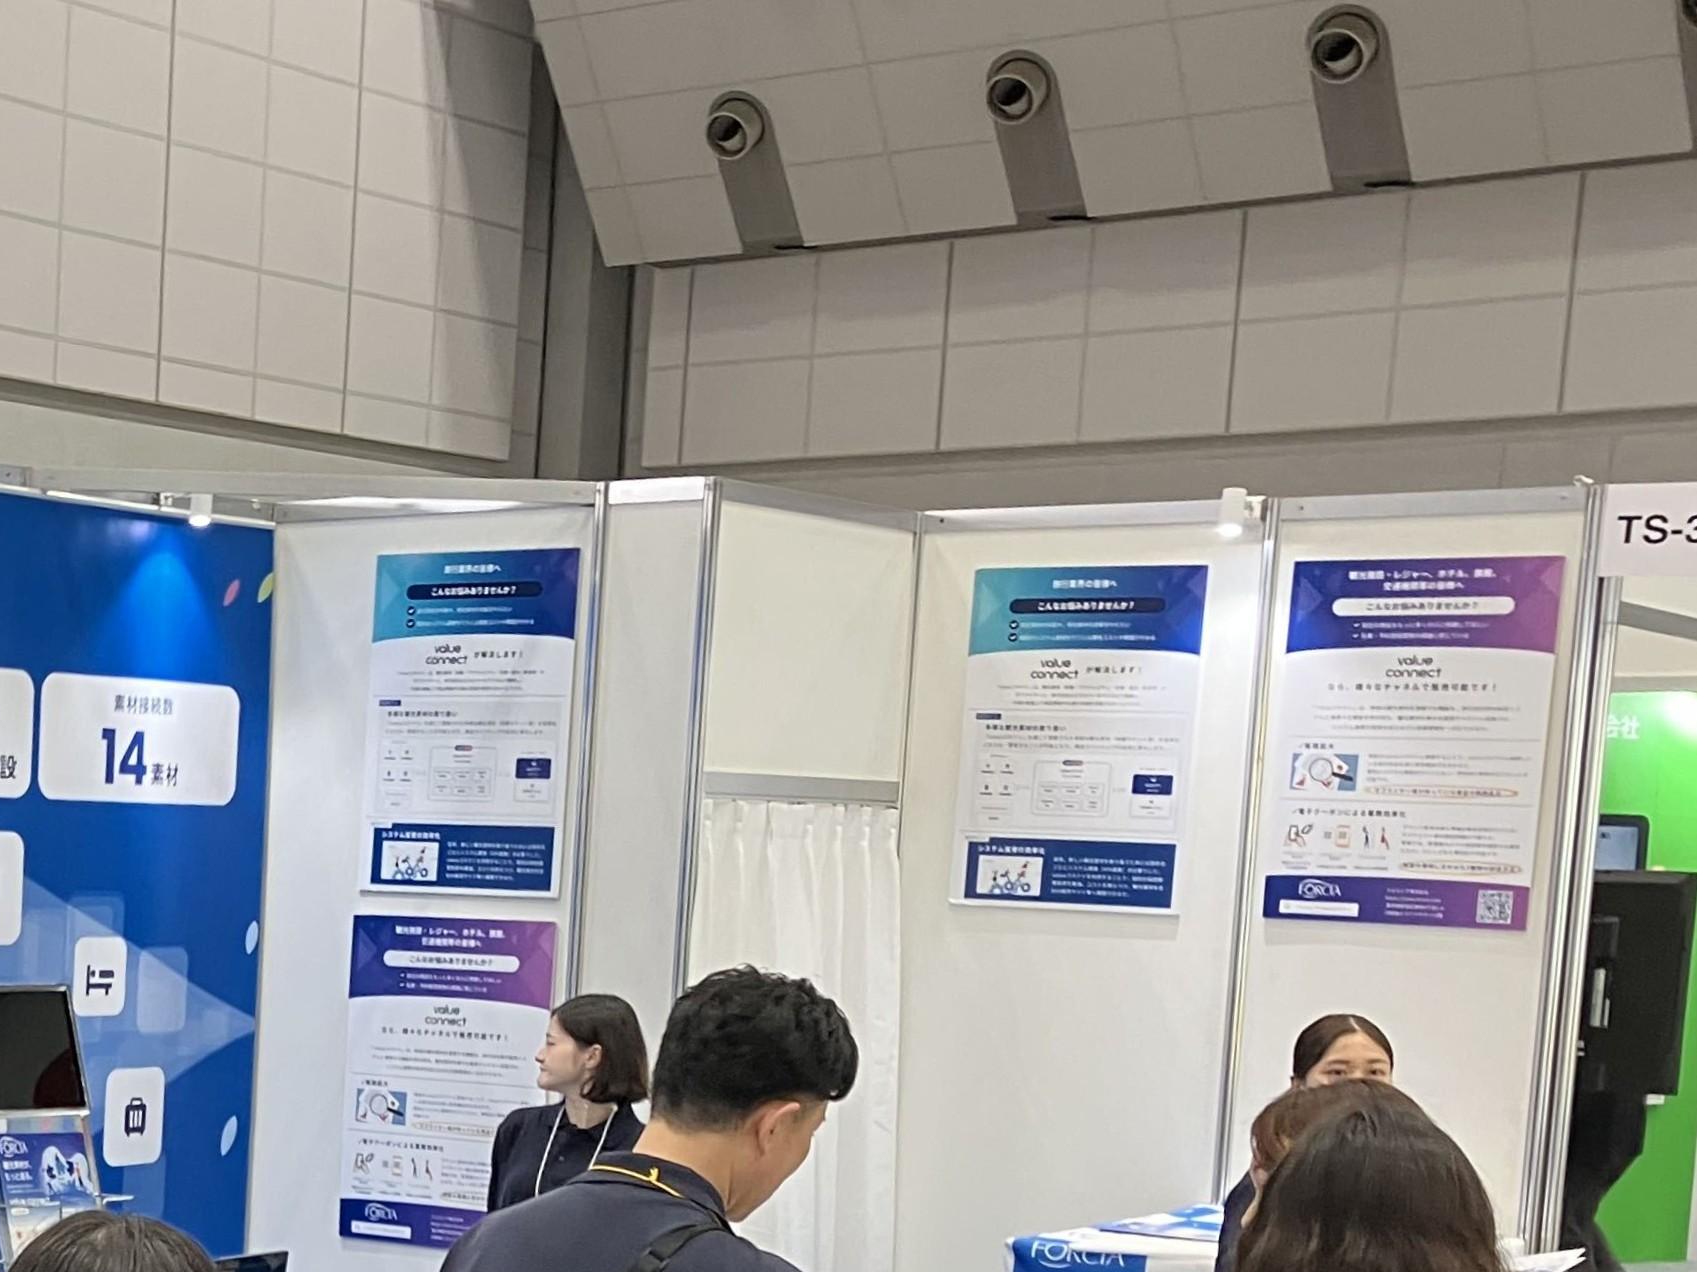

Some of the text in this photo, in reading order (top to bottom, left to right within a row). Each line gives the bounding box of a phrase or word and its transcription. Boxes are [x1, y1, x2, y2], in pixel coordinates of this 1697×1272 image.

[1397, 655, 1433, 666] value
[1030, 669, 1079, 680] connect
[1385, 668, 1442, 678] connect
[433, 1005, 460, 1016] value
[424, 1015, 467, 1027] connect
